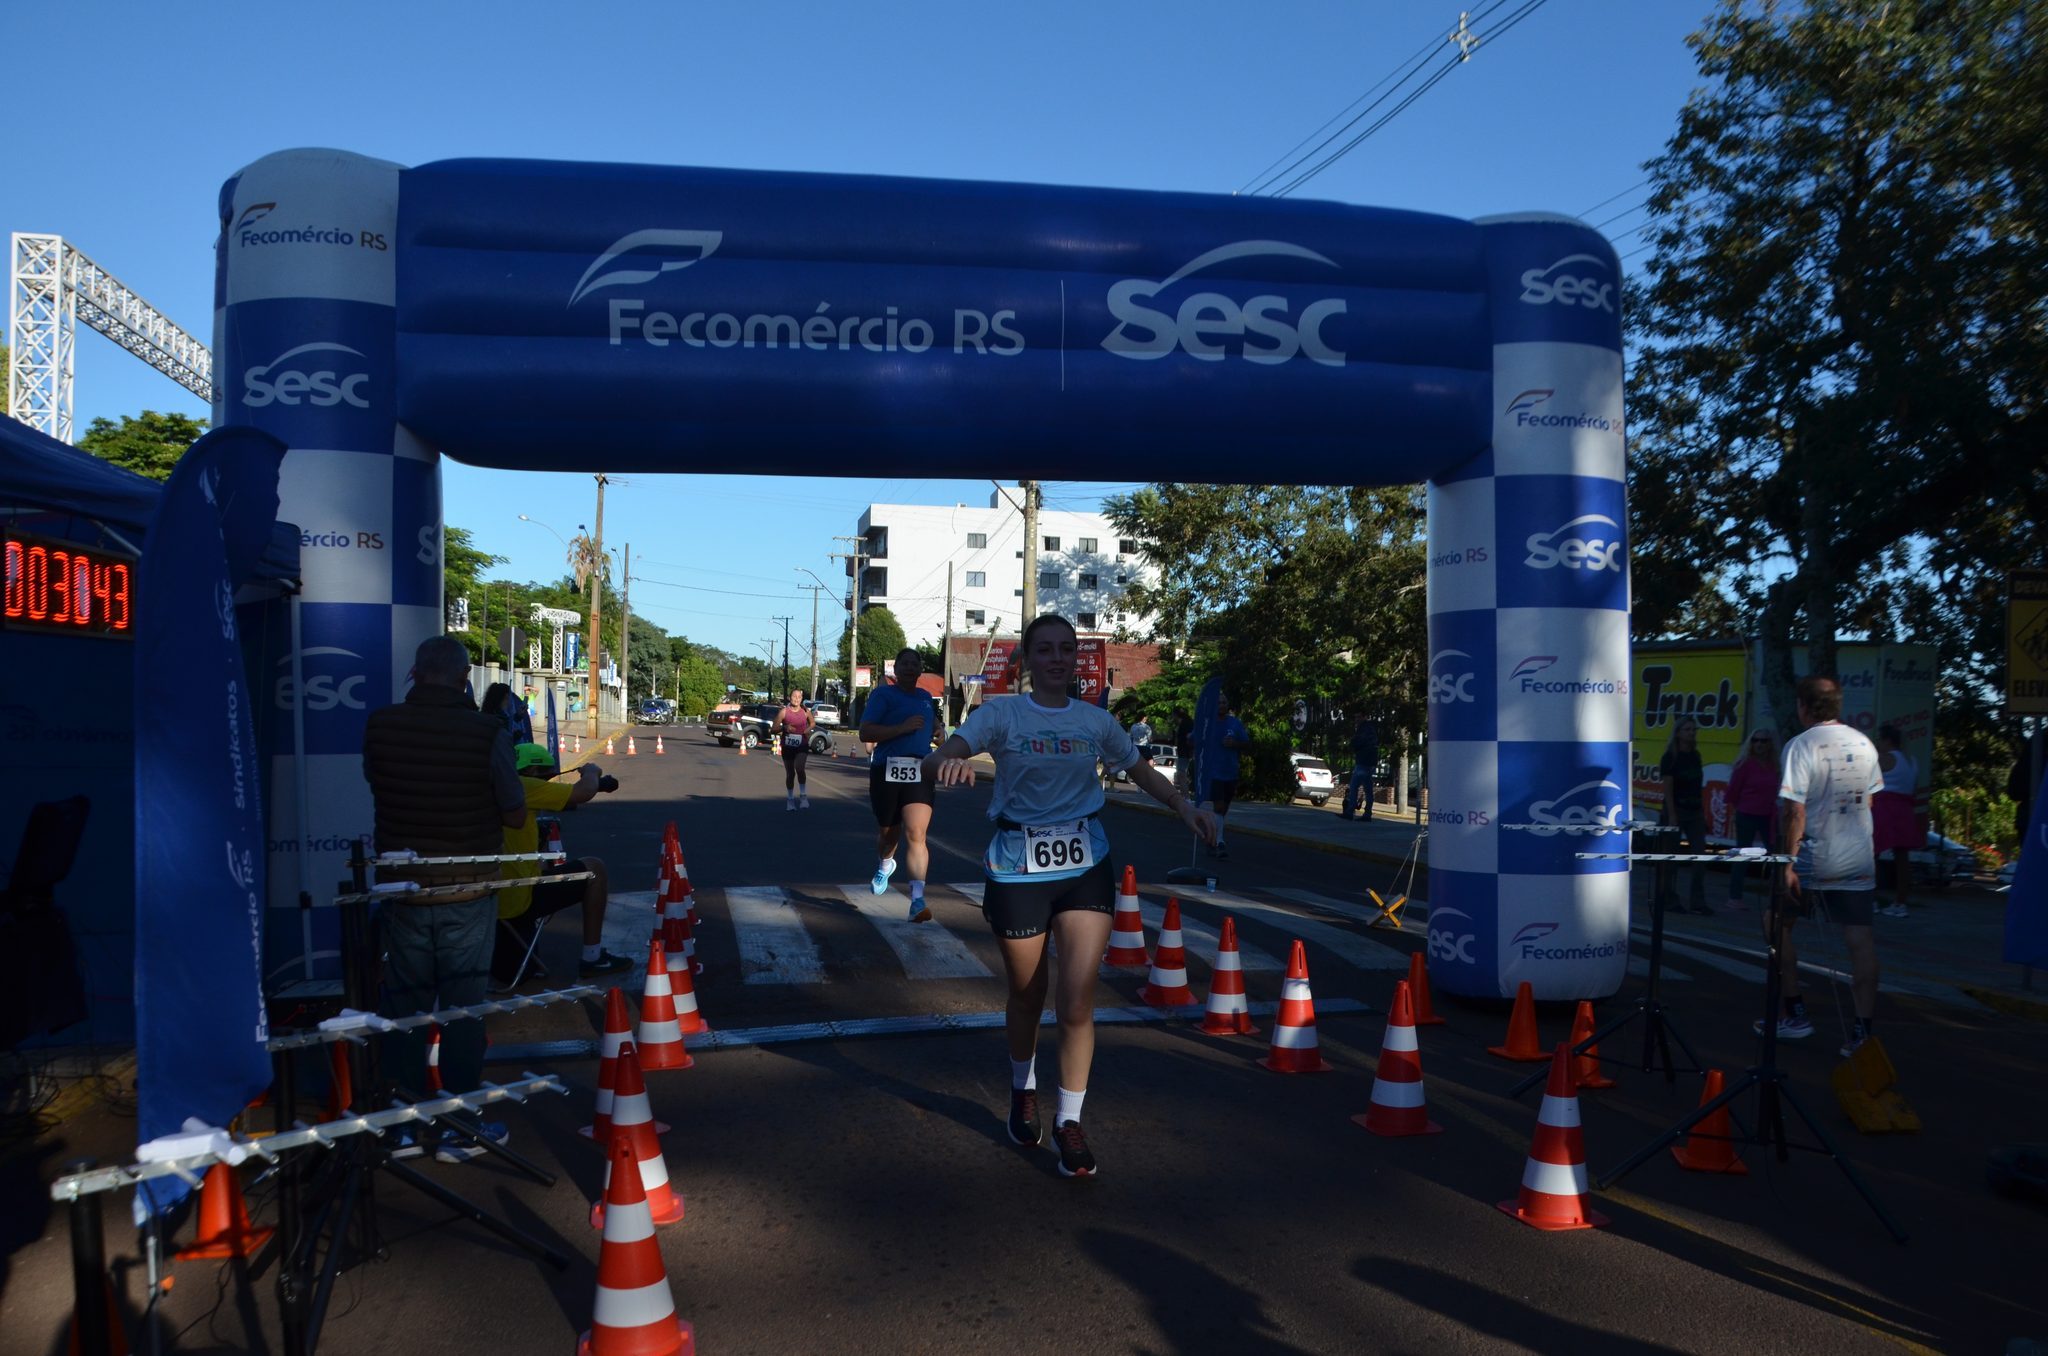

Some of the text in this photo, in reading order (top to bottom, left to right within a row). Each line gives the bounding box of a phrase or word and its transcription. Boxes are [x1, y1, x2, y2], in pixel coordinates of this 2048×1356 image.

[241, 225, 387, 251] Fecomércio RS
[1520, 268, 1614, 314] Sesc
[608, 299, 1025, 356] Fecomércio RS
[1100, 278, 1347, 367] Sesc
[241, 366, 369, 409] Sesc
[1517, 411, 1610, 432] Fecomércio
[357, 532, 385, 550] RS
[1524, 532, 1621, 573] Sesc
[1466, 547, 1488, 564] RS
[1521, 678, 1615, 696] Fecomércio
[1641, 665, 1740, 729] Truck
[891, 766, 917, 781] 853
[1467, 811, 1491, 826] RS
[1034, 837, 1084, 868] 696
[1006, 927, 1037, 937] RUN
[1522, 944, 1614, 961] Fecomércio
